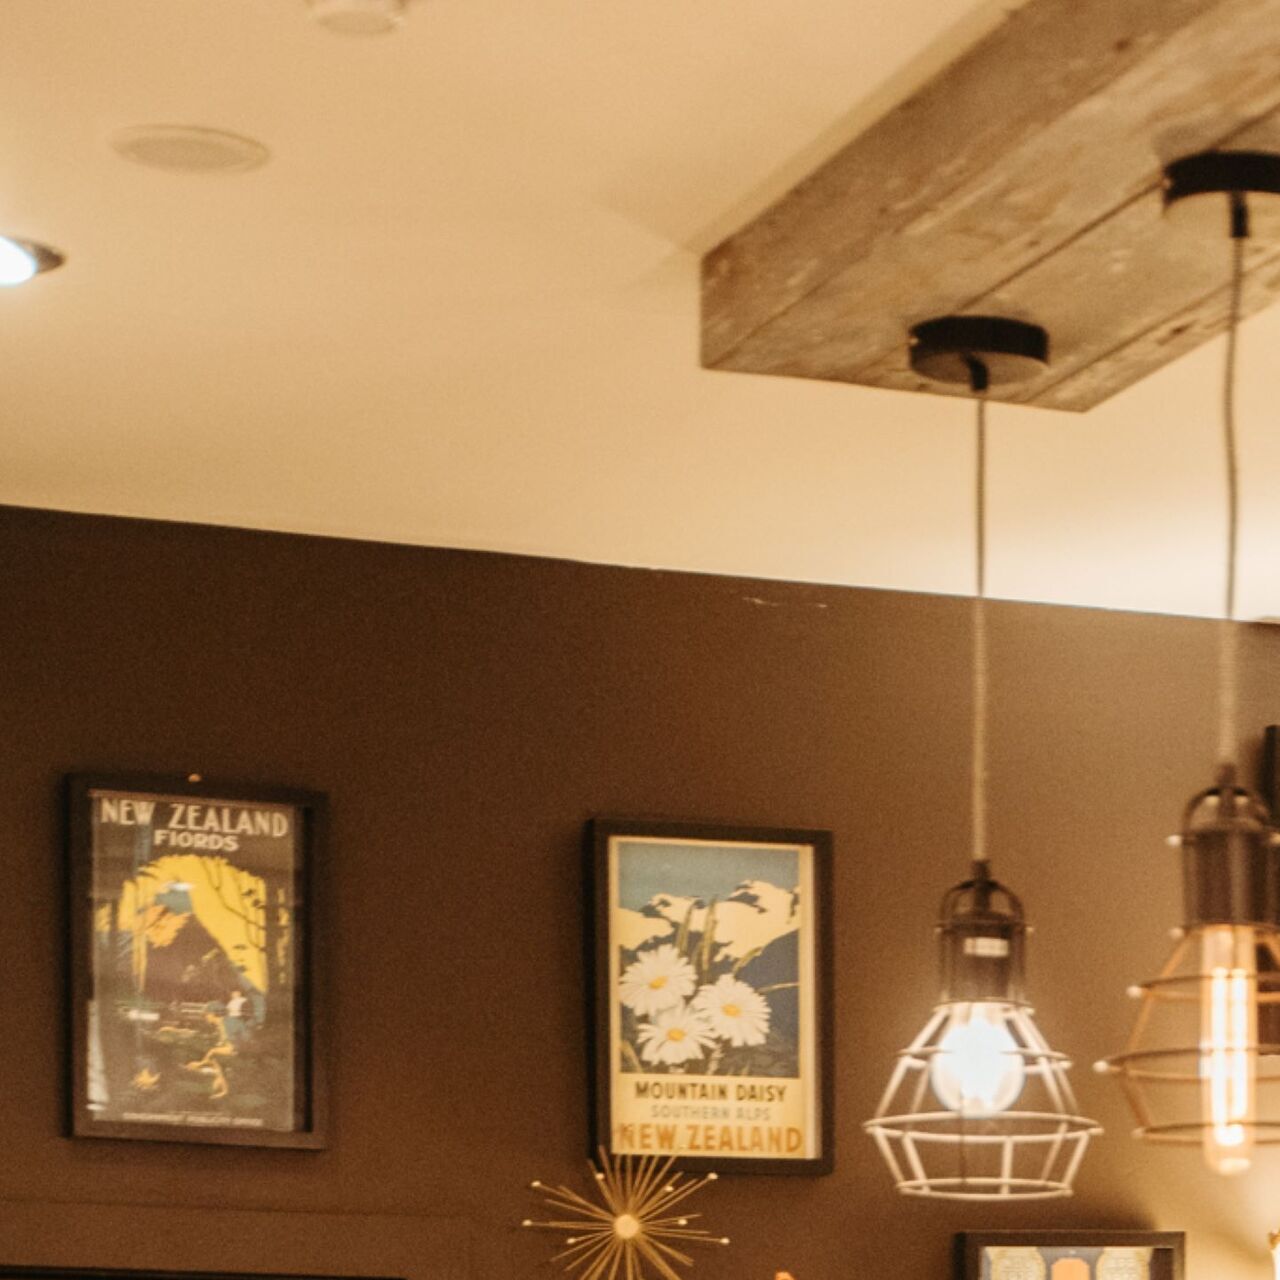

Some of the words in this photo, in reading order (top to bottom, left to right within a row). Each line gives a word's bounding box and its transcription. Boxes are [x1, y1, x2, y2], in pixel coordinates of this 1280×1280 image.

[100, 799, 155, 826] NEW
[169, 803, 289, 837] ZEALAND
[153, 829, 240, 851] FIORDS
[635, 1081, 728, 1101] MOUNTAIN
[736, 1083, 788, 1102] DAISY
[651, 1104, 730, 1120] SOUTHERN
[736, 1107, 771, 1121] ALPS
[619, 1123, 677, 1150] NEW
[686, 1124, 803, 1153] ZEALAND
